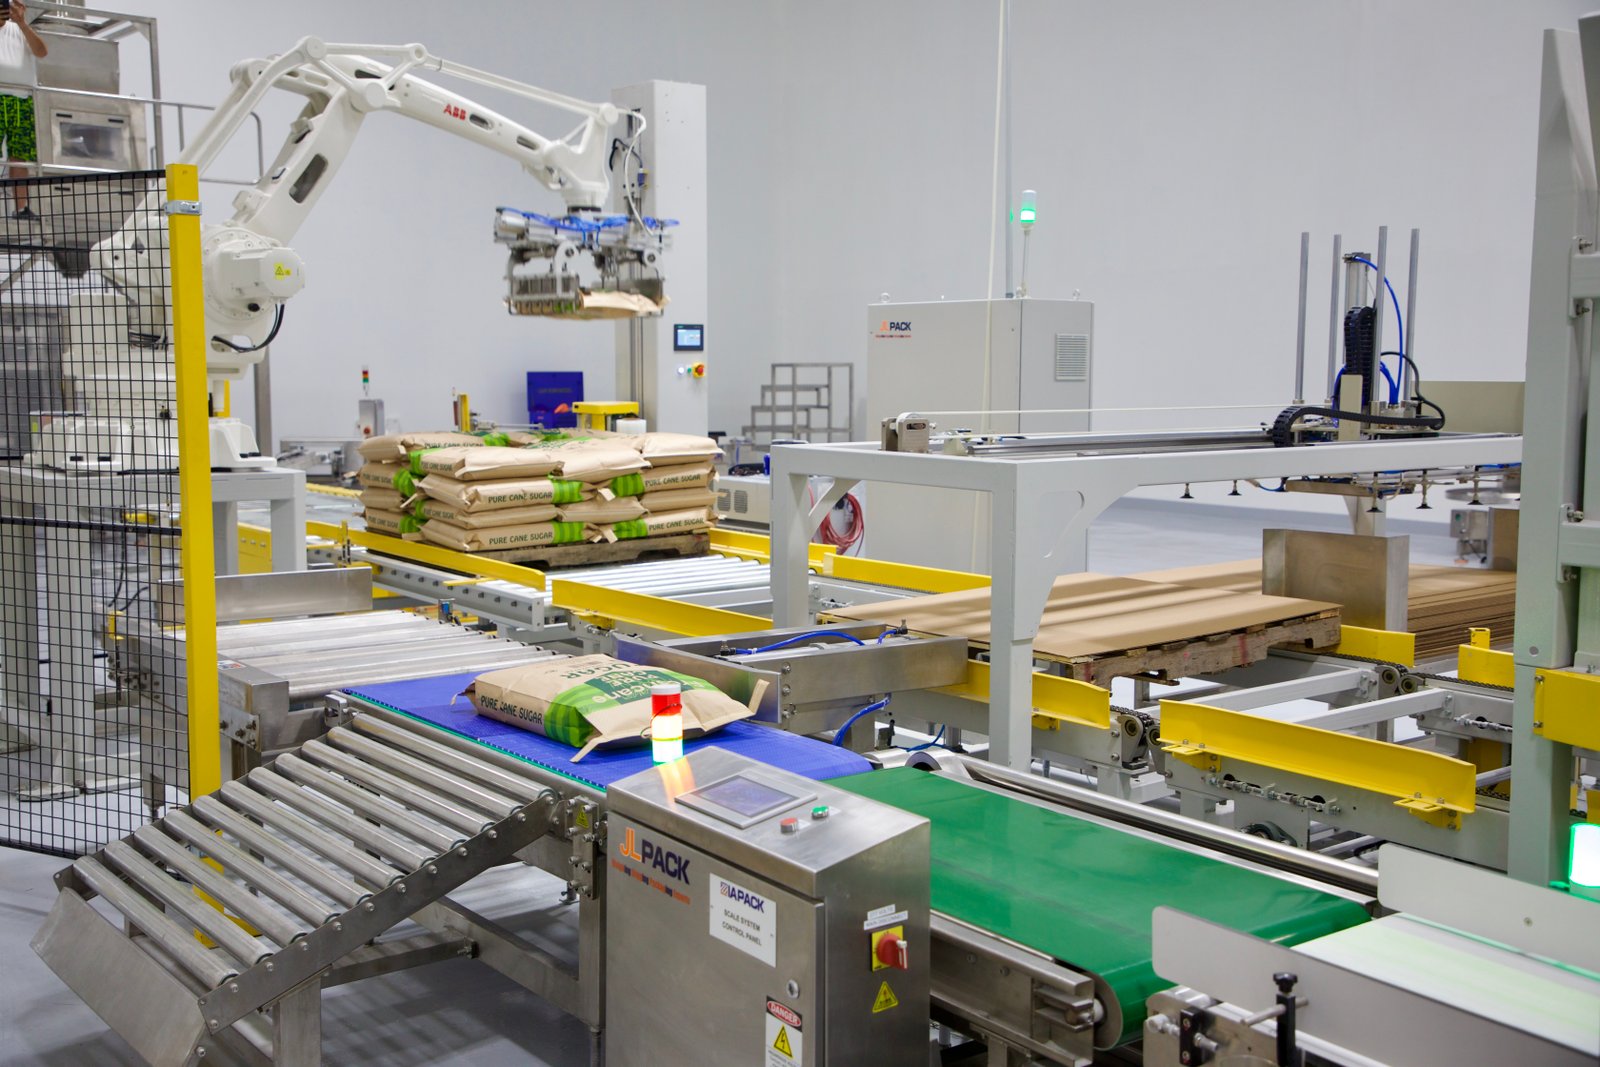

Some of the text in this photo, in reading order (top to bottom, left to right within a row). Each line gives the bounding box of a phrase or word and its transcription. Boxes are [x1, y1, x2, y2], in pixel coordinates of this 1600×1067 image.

[443, 103, 466, 121] ABB
[645, 474, 701, 488] PURE CANE SUGAR
[488, 491, 553, 504] PURE CANE SUGAR
[649, 517, 705, 531] PURE CANE SUGAR
[489, 532, 553, 545] PURE CANE SUGAR
[480, 695, 499, 711] PURE
[518, 707, 543, 725] SUGAR
[619, 827, 690, 885] JLPACK
[723, 909, 761, 932] SCALE SYSTEM
[722, 921, 762, 946] CONTROL PANEL
[770, 1003, 799, 1026] DANGER
